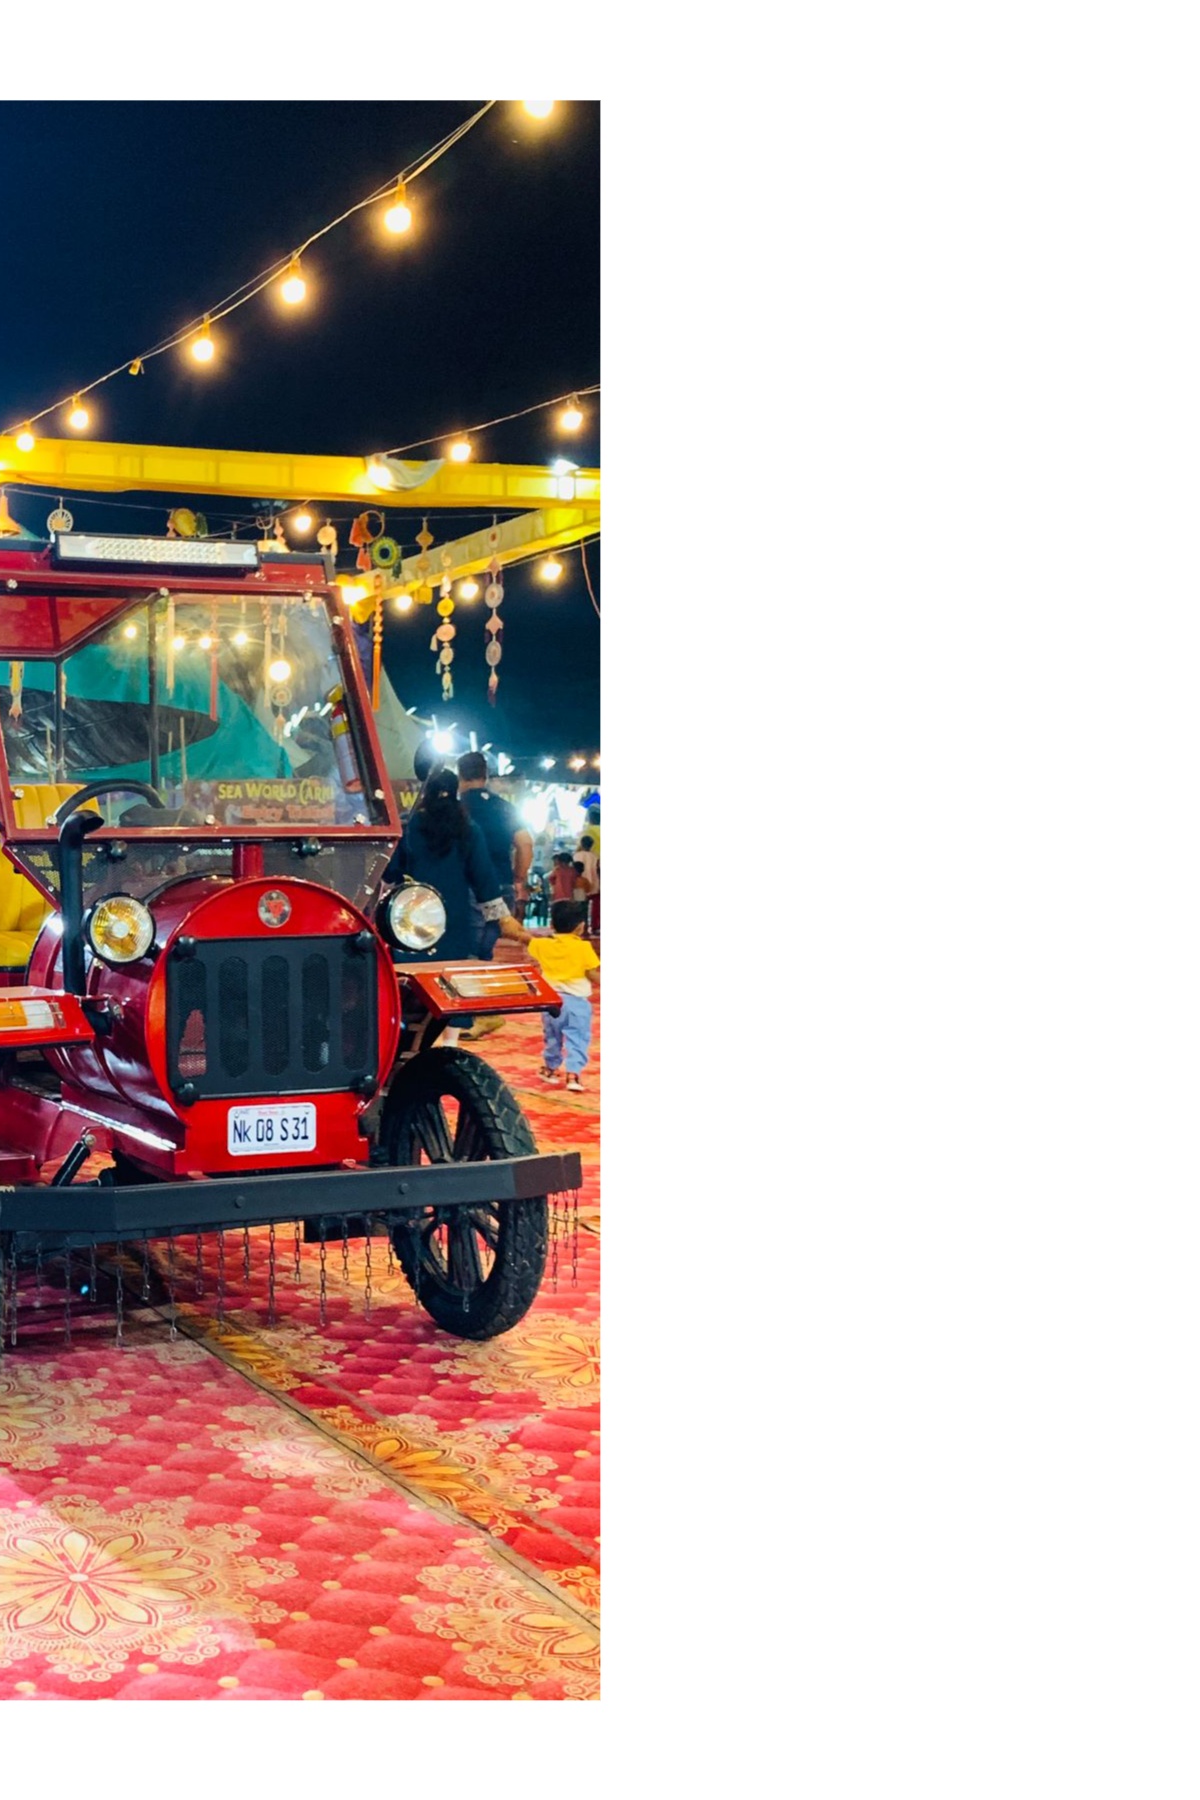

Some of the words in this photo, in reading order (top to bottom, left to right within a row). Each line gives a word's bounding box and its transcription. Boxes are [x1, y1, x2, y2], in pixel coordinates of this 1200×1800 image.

[218, 783, 243, 799] SEA
[244, 782, 297, 802] WORLD
[256, 1118, 274, 1142] 08
[280, 1117, 289, 1141] S
[292, 1116, 309, 1140] 31
